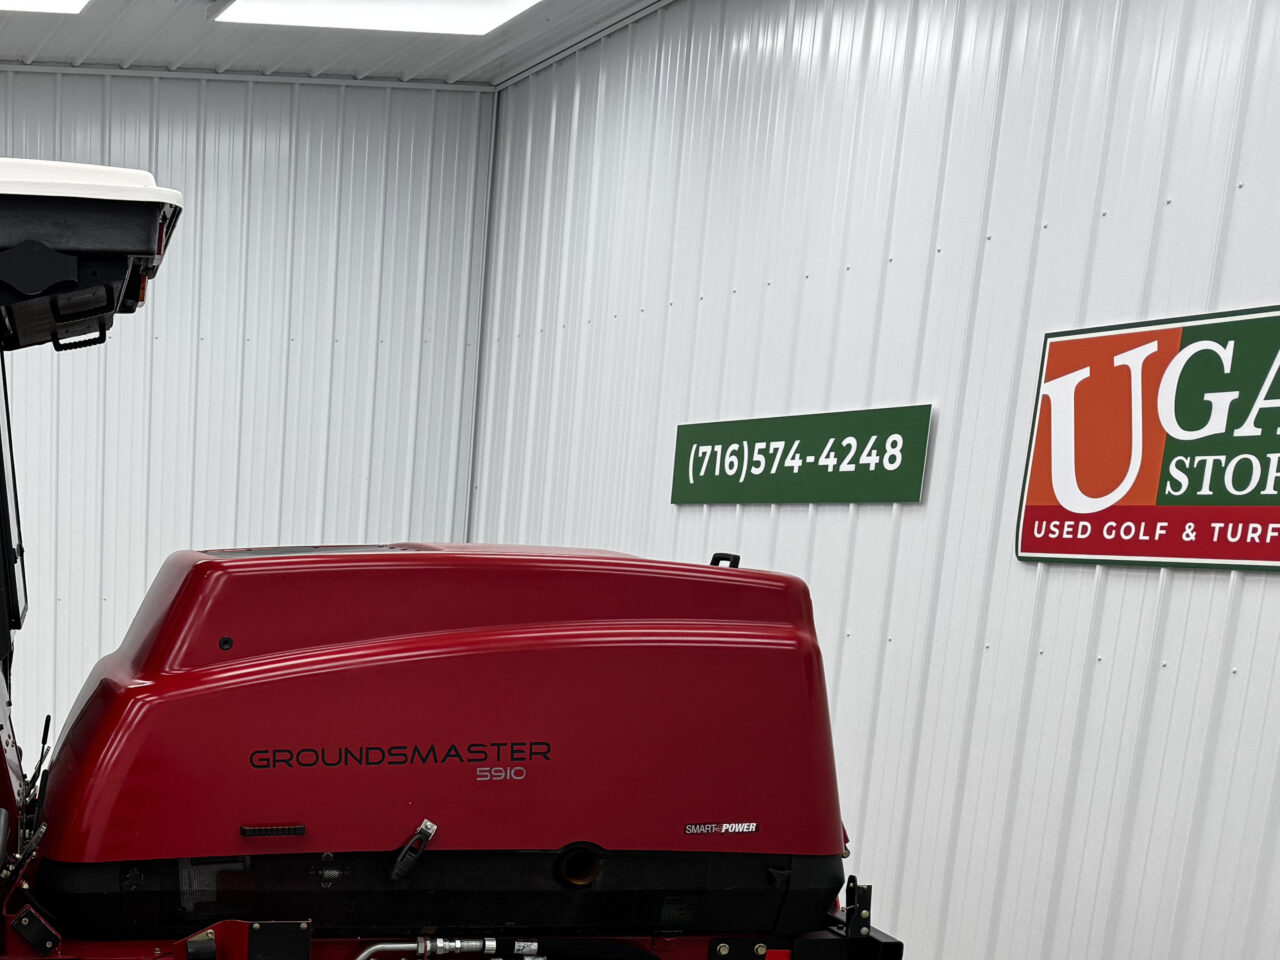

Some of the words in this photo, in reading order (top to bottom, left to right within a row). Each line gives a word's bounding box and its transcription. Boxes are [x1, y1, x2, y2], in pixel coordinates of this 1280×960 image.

[688, 433, 904, 484] (716)574-4248
[1033, 521, 1092, 539] USED
[1102, 521, 1169, 541] GOLF
[1181, 522, 1197, 542] &
[1210, 522, 1280, 543] TURF
[249, 741, 552, 769] GROUNDSMASTER
[476, 766, 527, 781] 5910
[721, 822, 757, 833] POWER
